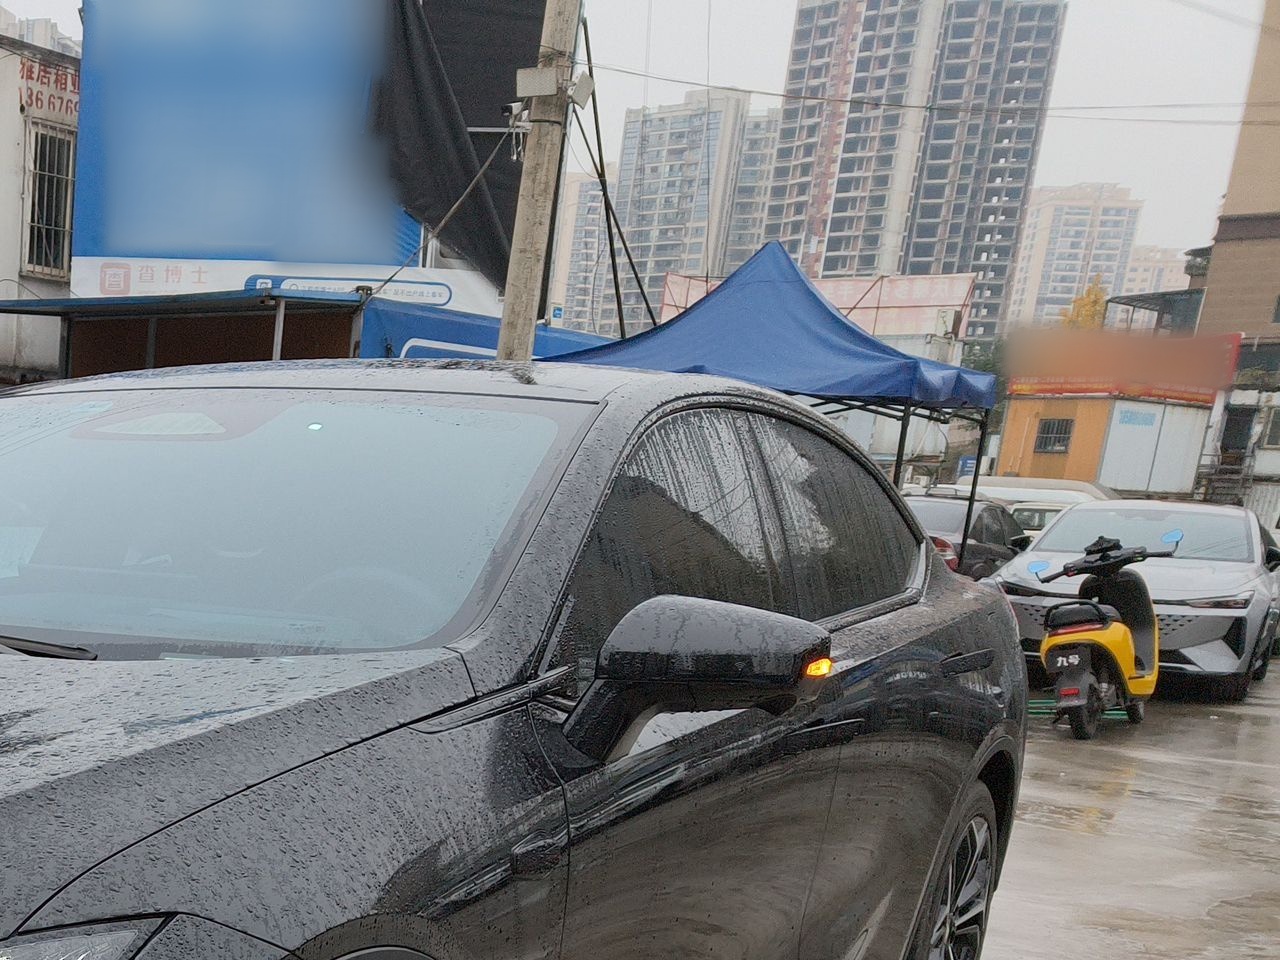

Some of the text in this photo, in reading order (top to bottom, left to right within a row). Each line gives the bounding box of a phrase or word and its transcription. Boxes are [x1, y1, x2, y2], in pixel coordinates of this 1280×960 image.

[138, 265, 209, 284] 查博士
[1056, 654, 1080, 667] 九号
